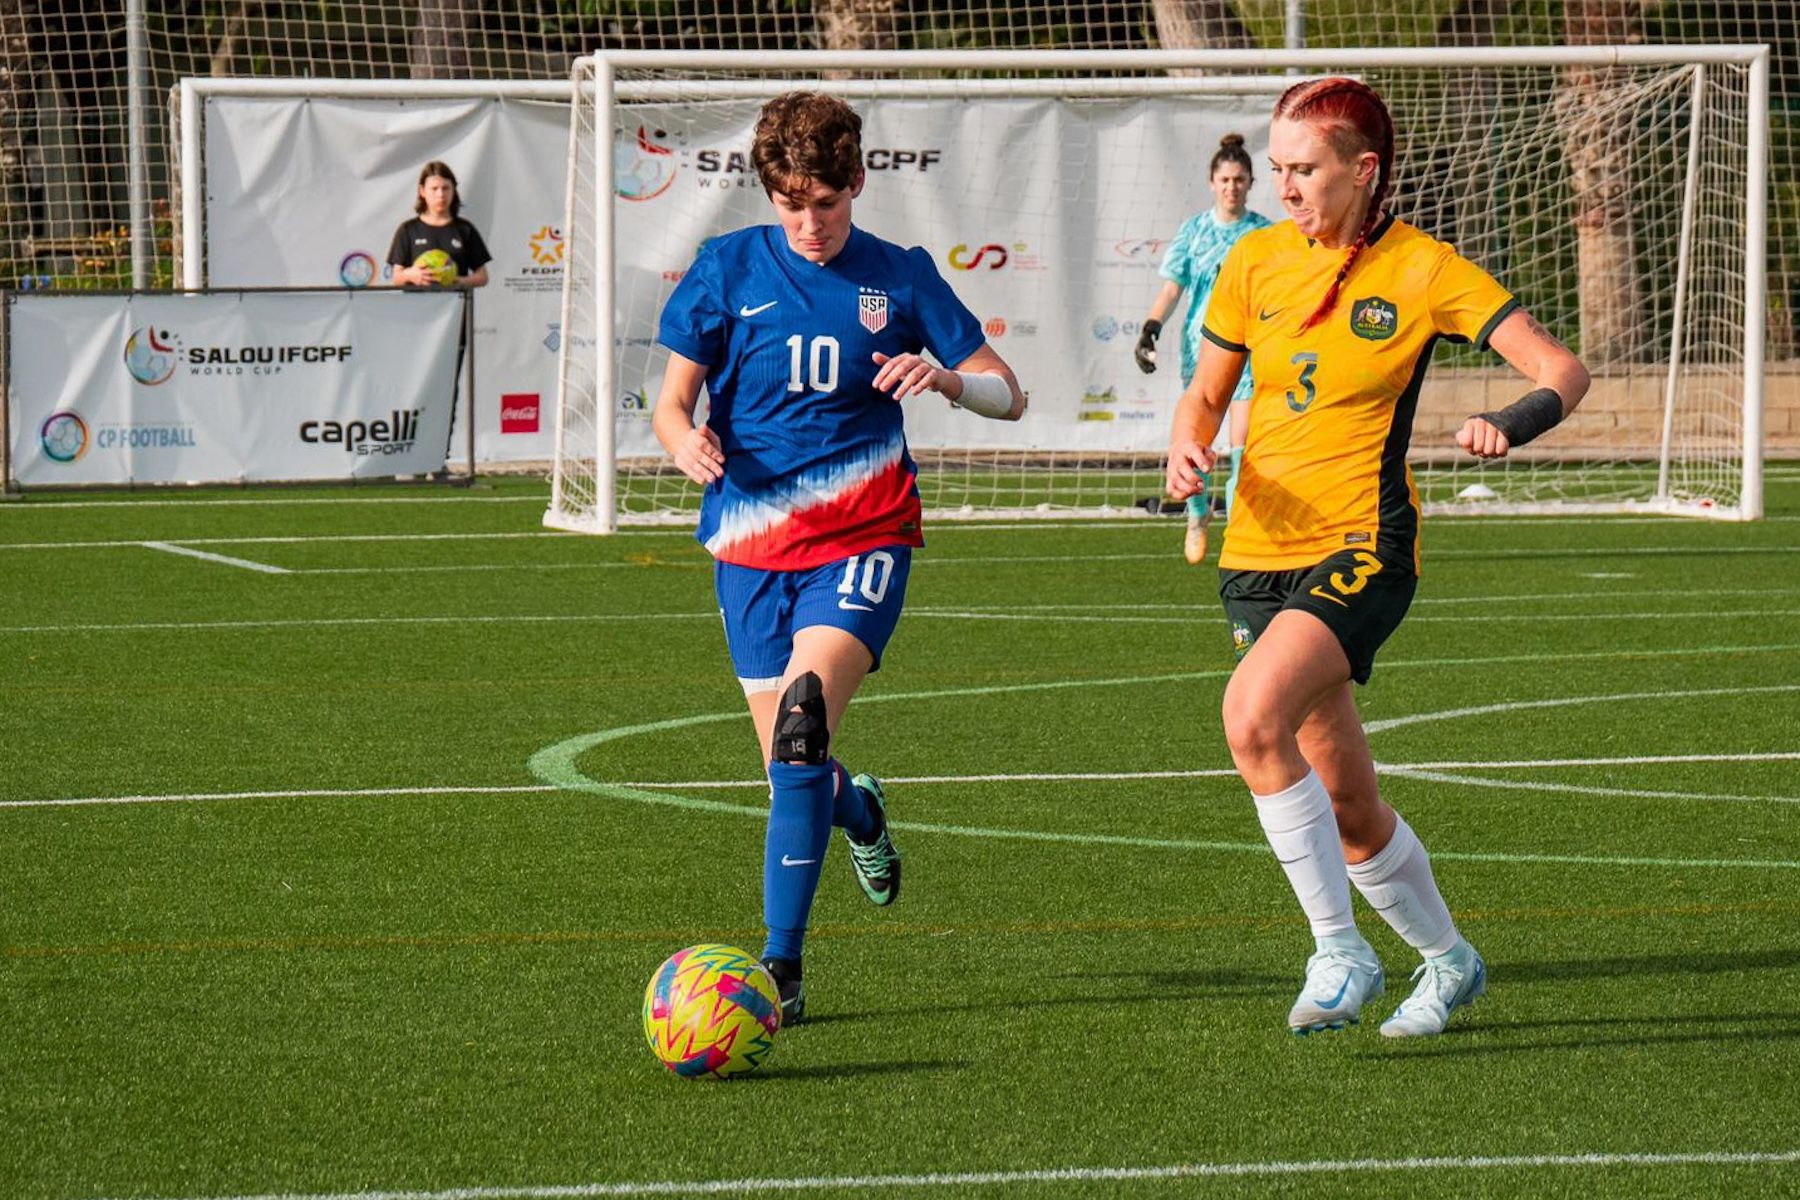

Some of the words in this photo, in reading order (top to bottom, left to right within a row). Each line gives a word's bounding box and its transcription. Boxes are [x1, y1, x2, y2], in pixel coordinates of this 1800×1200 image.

[867, 149, 941, 171] CPF
[698, 178, 758, 189] WORL
[521, 267, 564, 275] FEDP
[860, 297, 886, 312] USA
[189, 348, 274, 364] SALOU
[278, 346, 352, 363] IFCPF
[786, 334, 840, 393] 10
[190, 366, 243, 375] WORLD
[253, 366, 282, 375] CUP
[1286, 352, 1318, 413] 3
[97, 428, 117, 448] CP
[119, 427, 196, 448] FOOTBALL
[299, 409, 419, 452] capelli
[356, 442, 414, 456] SPORT
[836, 550, 895, 604] 10
[1330, 552, 1383, 595] 3
